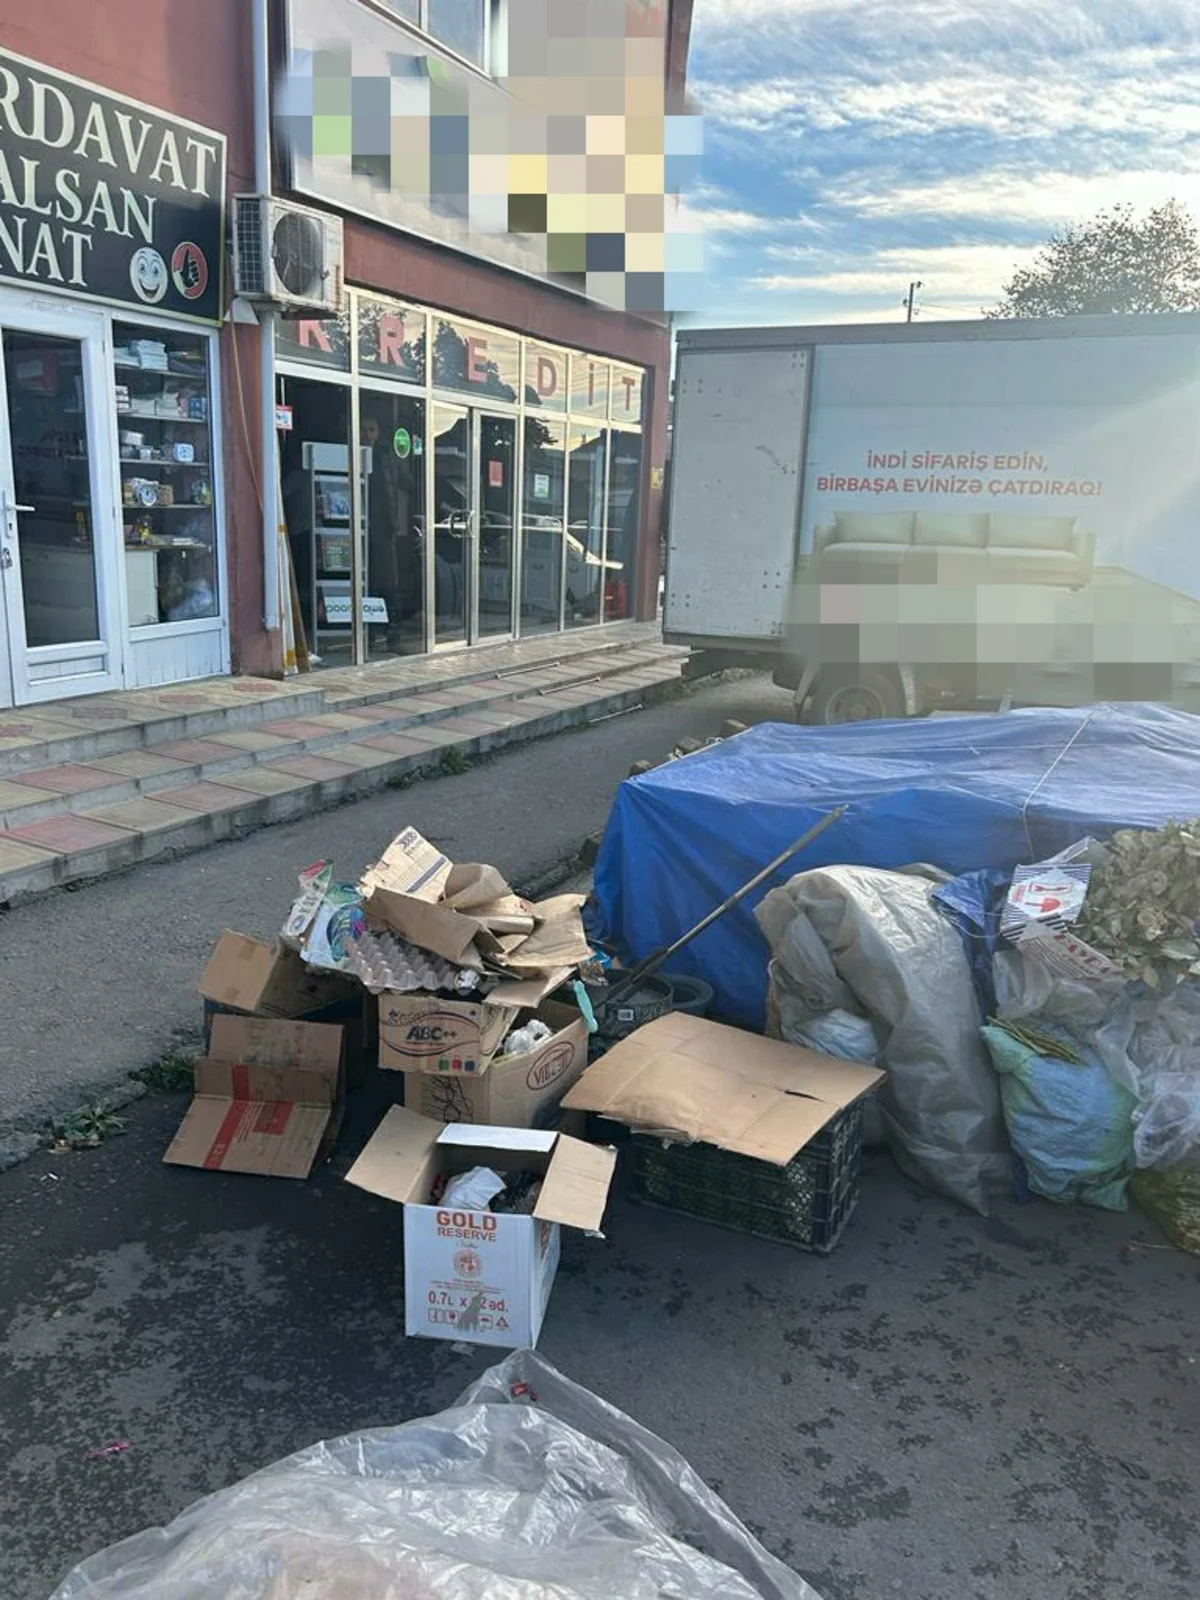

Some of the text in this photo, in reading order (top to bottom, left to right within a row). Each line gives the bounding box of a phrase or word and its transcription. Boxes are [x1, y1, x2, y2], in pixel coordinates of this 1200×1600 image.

[867, 450, 1048, 473] İNDİ SİFARİŞ EDİN,
[817, 474, 1102, 497] BİRBAŞA EVİNİZƏ ÇATDIRAQ!
[436, 1210, 497, 1231] GOLD
[437, 1226, 497, 1242] RESERVE
[428, 1290, 454, 1306] 0.7L
